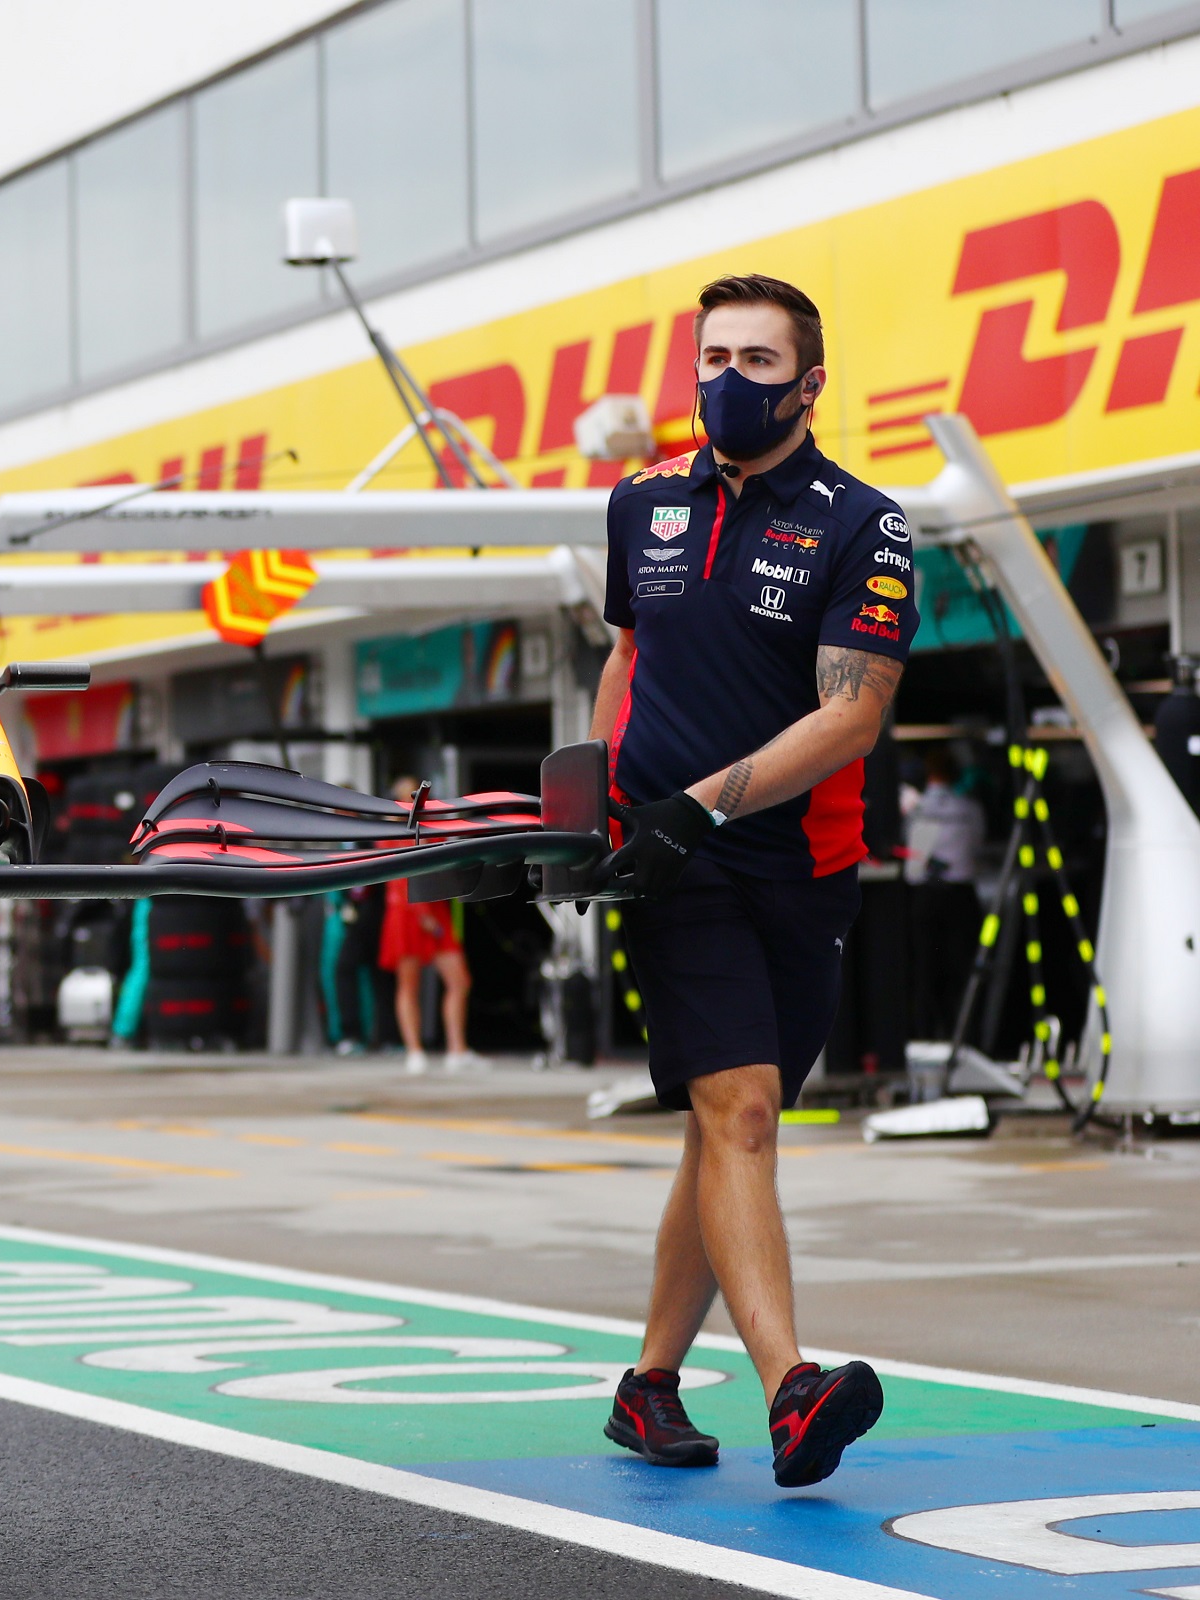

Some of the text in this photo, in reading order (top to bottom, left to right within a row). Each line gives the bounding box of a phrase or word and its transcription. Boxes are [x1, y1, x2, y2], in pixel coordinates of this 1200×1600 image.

[657, 509, 686, 520] TAG
[653, 522, 686, 538] HEUER
[771, 518, 824, 536] ASTON MARTIN
[764, 529, 795, 543] Red Bull
[761, 538, 816, 555] RACING
[638, 565, 688, 574] ASTON MARTIN
[752, 558, 794, 582] Mobil
[879, 581, 903, 595] RAUCH
[750, 604, 793, 622] HONDA
[851, 617, 900, 641] Red Bull
